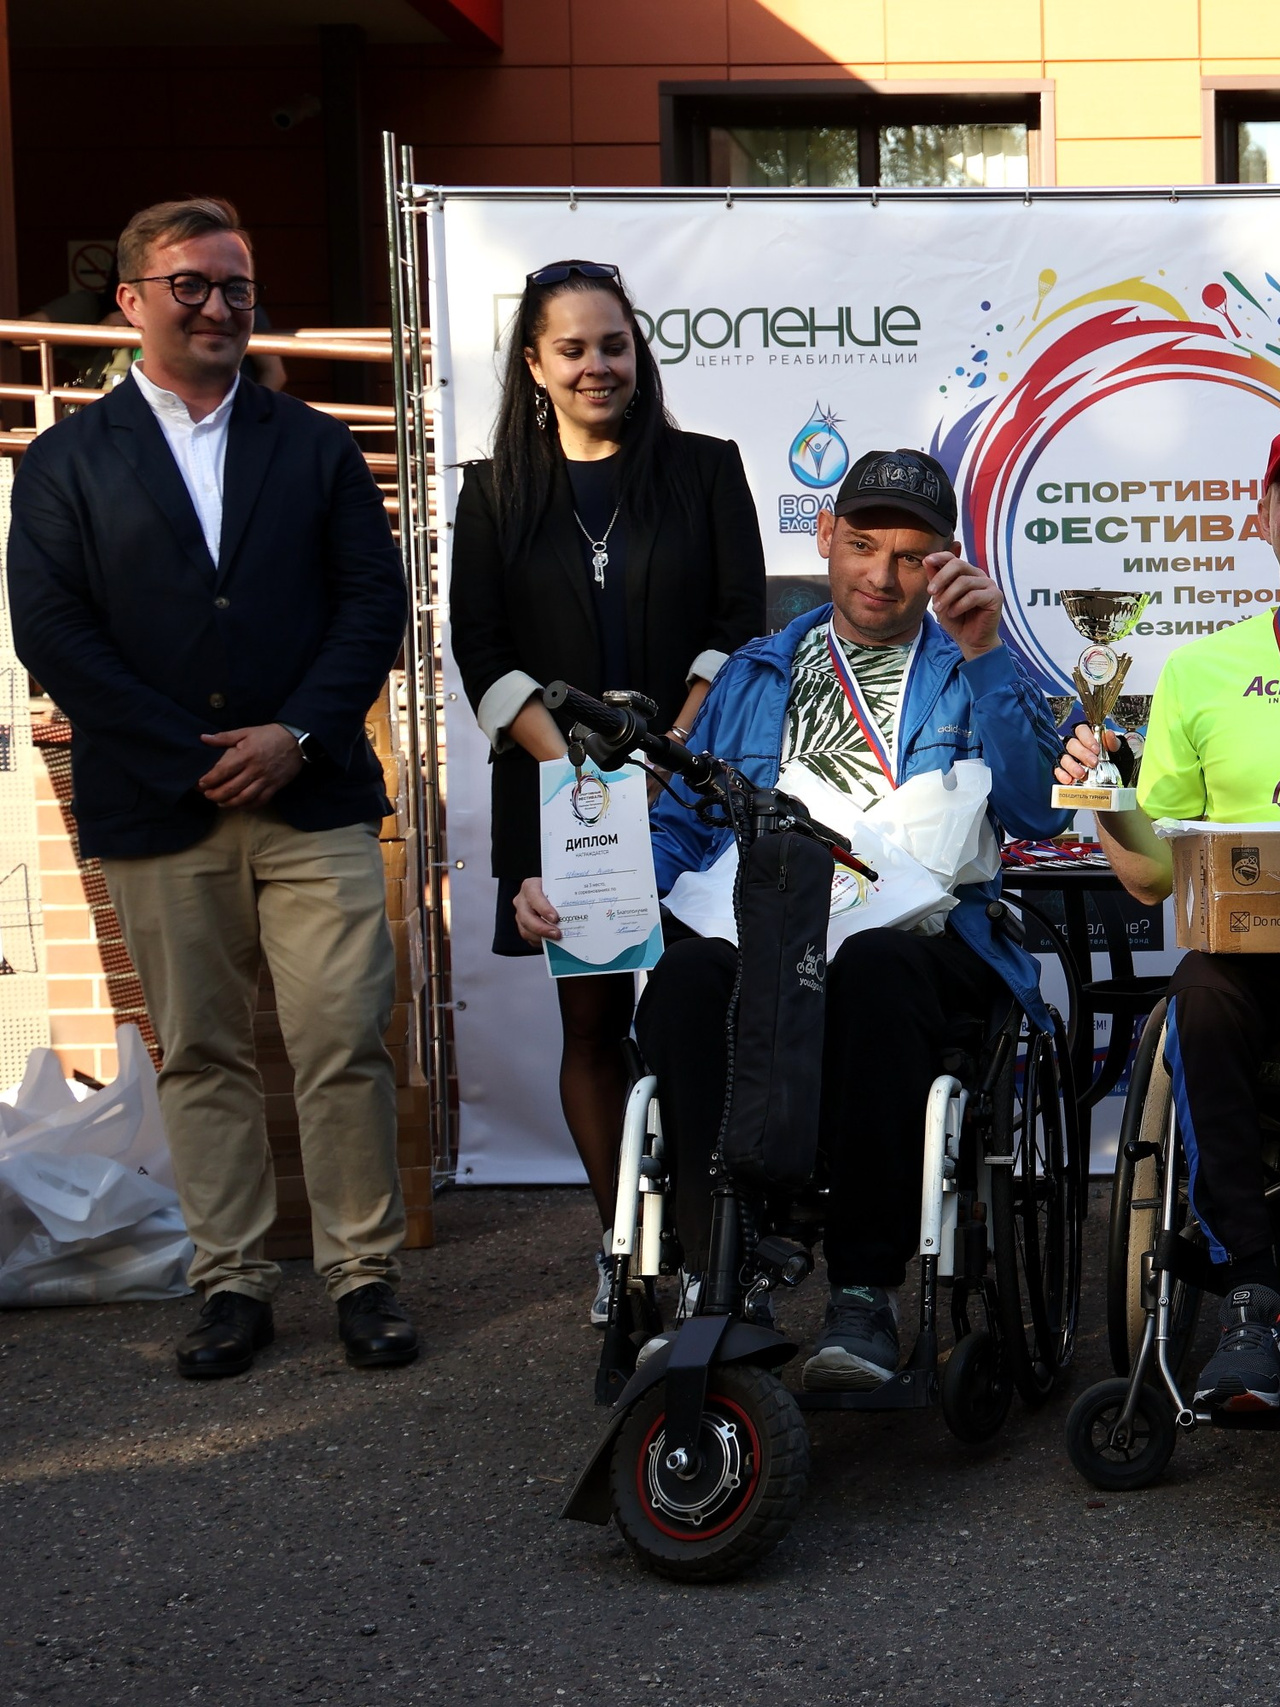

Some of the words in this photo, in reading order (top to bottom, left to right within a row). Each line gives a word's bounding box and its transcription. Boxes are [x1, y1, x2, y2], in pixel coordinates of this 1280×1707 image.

[695, 354, 756, 367] ЦЕНТР
[768, 352, 919, 366] РЕАБИЛИТАЦИИ
[1036, 479, 1265, 504] СПОРТИВН
[1024, 514, 1266, 545] ФЕСТИВА
[1123, 556, 1235, 573] имени
[565, 833, 618, 852] ДИПЛОМ
[559, 914, 588, 923] еодоление
[1253, 916, 1269, 926] Do
